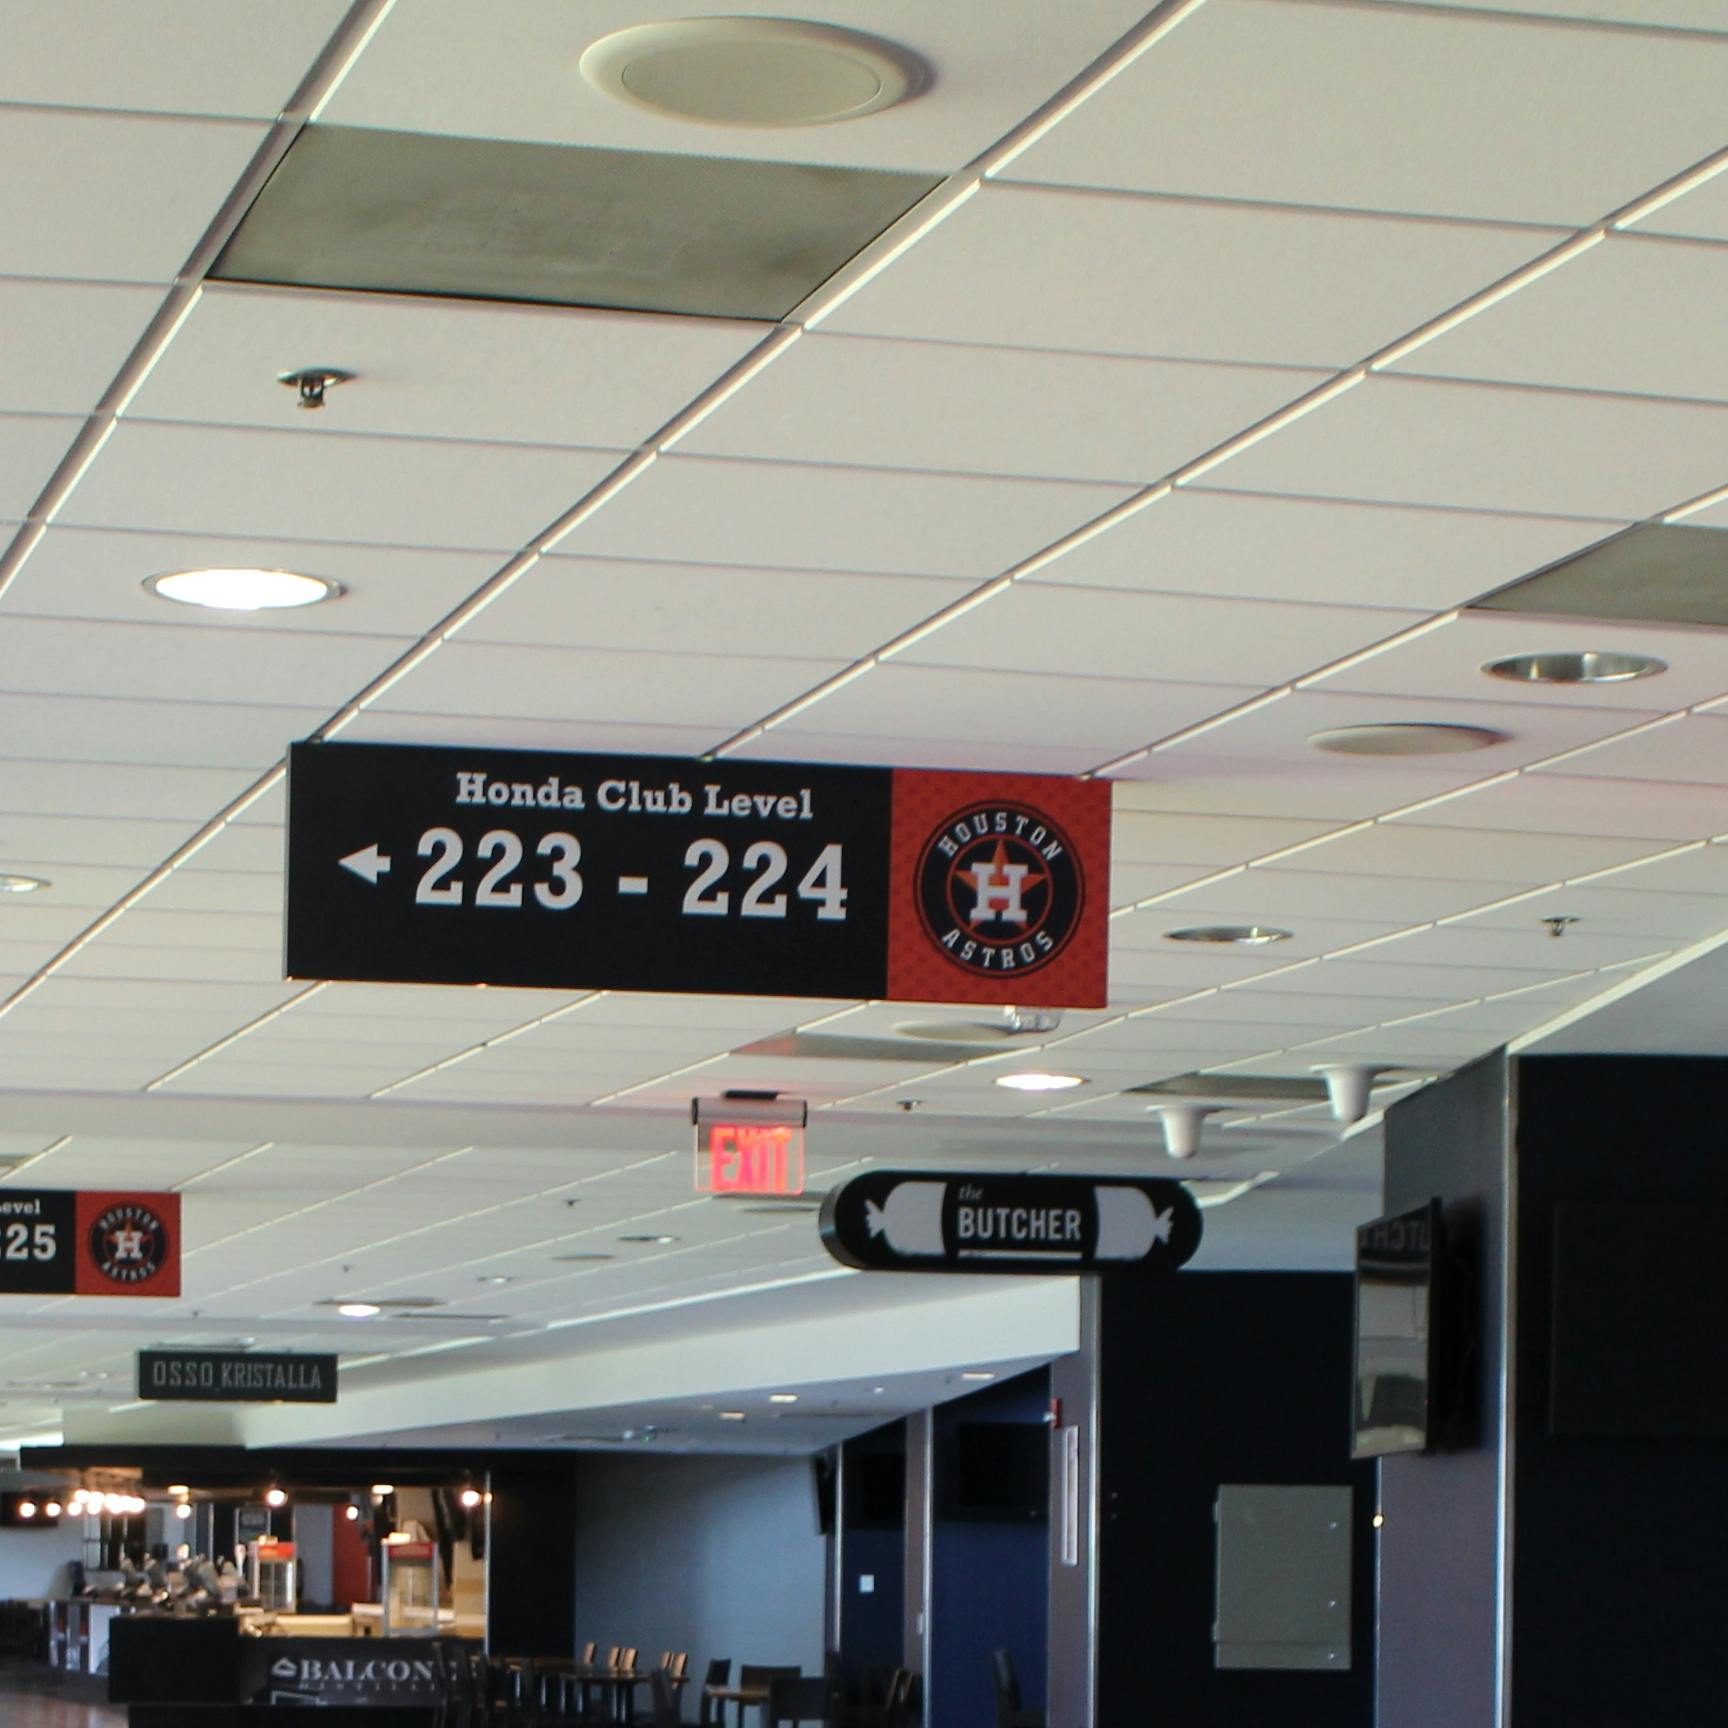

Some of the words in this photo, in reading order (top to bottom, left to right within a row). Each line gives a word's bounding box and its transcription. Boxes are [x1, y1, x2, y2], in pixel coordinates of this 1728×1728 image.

[456, 771, 585, 810] Honda
[597, 779, 692, 814] Club
[703, 784, 814, 820] Level
[938, 811, 1062, 862] HOUSTON
[414, 827, 584, 911] 223
[682, 838, 848, 922] 224
[942, 928, 1054, 970] ASTROS
[710, 1125, 793, 1193] EXIT
[959, 1184, 984, 1200] the
[99, 1207, 159, 1230] HOUSTON
[958, 1206, 1082, 1240] BUTCHER
[153, 1361, 214, 1388] OSSO
[222, 1361, 322, 1390] KRISTALLA
